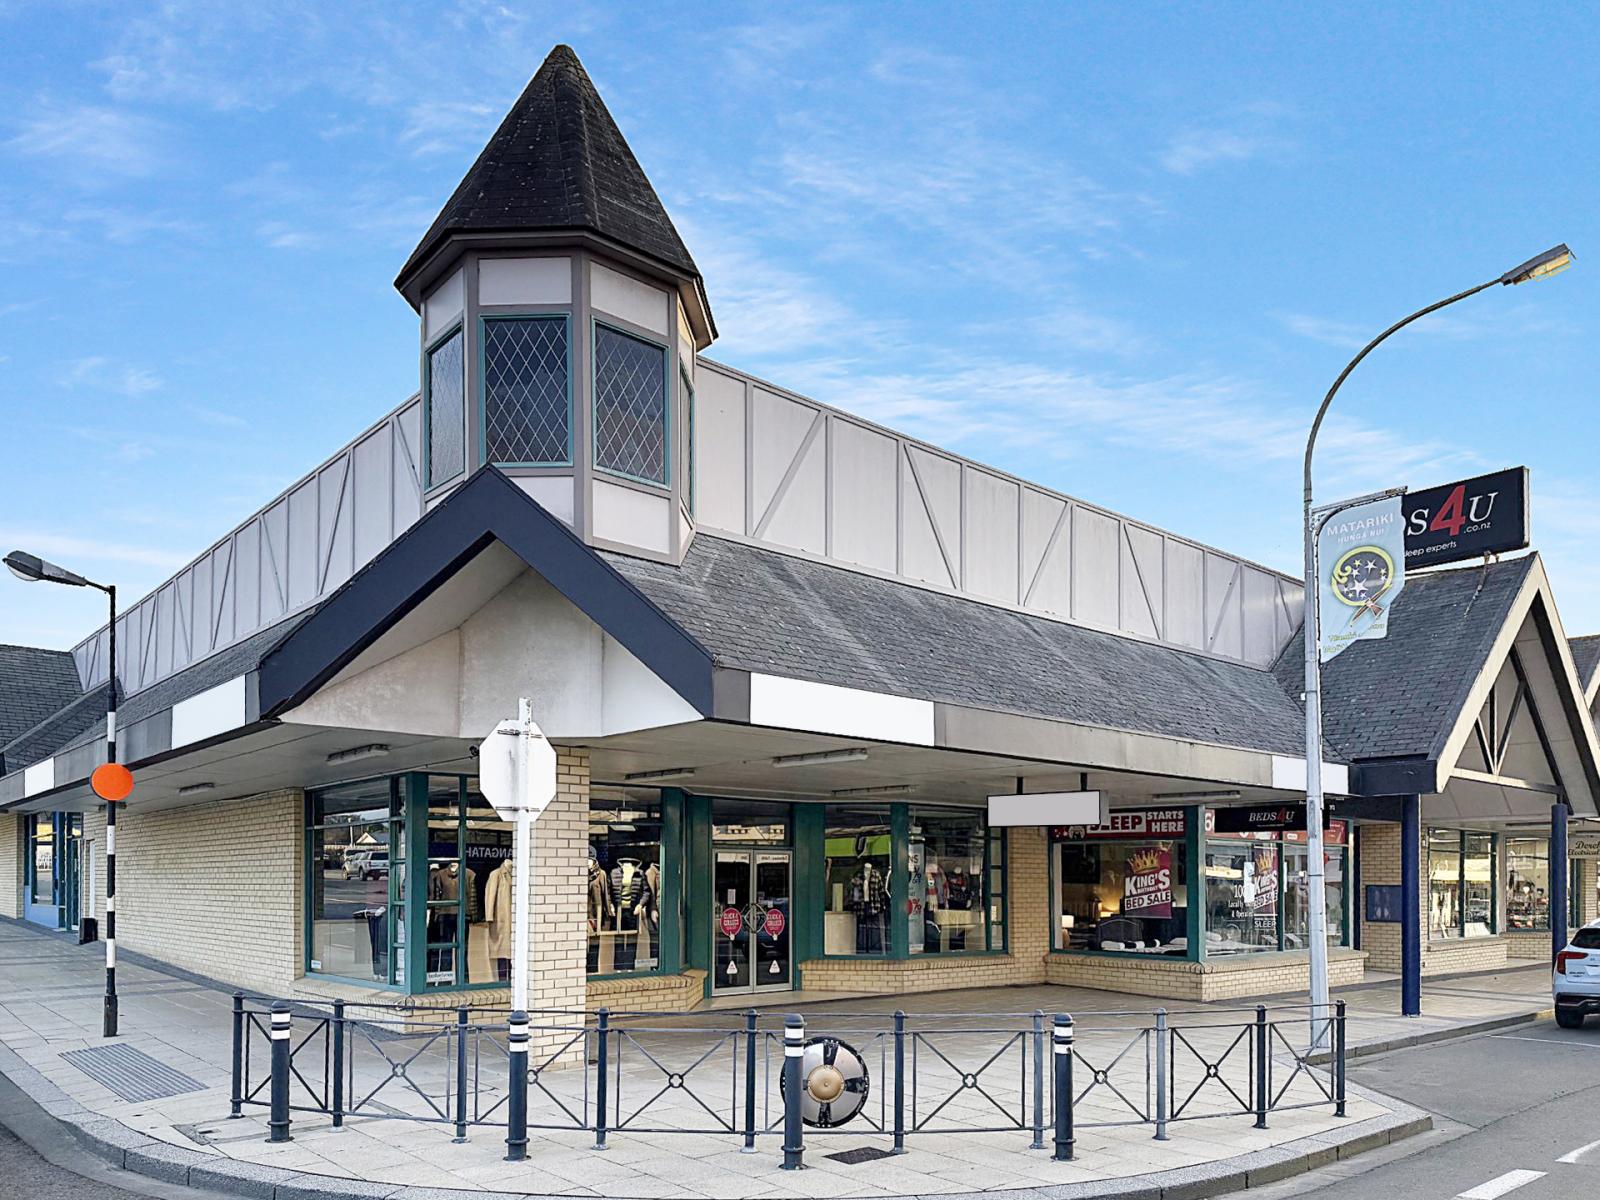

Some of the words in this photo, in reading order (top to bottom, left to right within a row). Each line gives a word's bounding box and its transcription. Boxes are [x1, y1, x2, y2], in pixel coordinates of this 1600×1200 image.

[1404, 485, 1499, 536] S4U
[1327, 512, 1394, 536] MATARIKI
[1463, 521, 1491, 533] .co.nz
[1405, 548, 1425, 558] leep
[1425, 540, 1457, 554] experts
[1147, 810, 1184, 820] STARTS
[1248, 807, 1295, 823] BEDS4U
[1151, 821, 1184, 833] HERE
[1125, 868, 1170, 897] KING'S
[1126, 897, 1144, 909] BED
[1147, 891, 1170, 905] SALE
